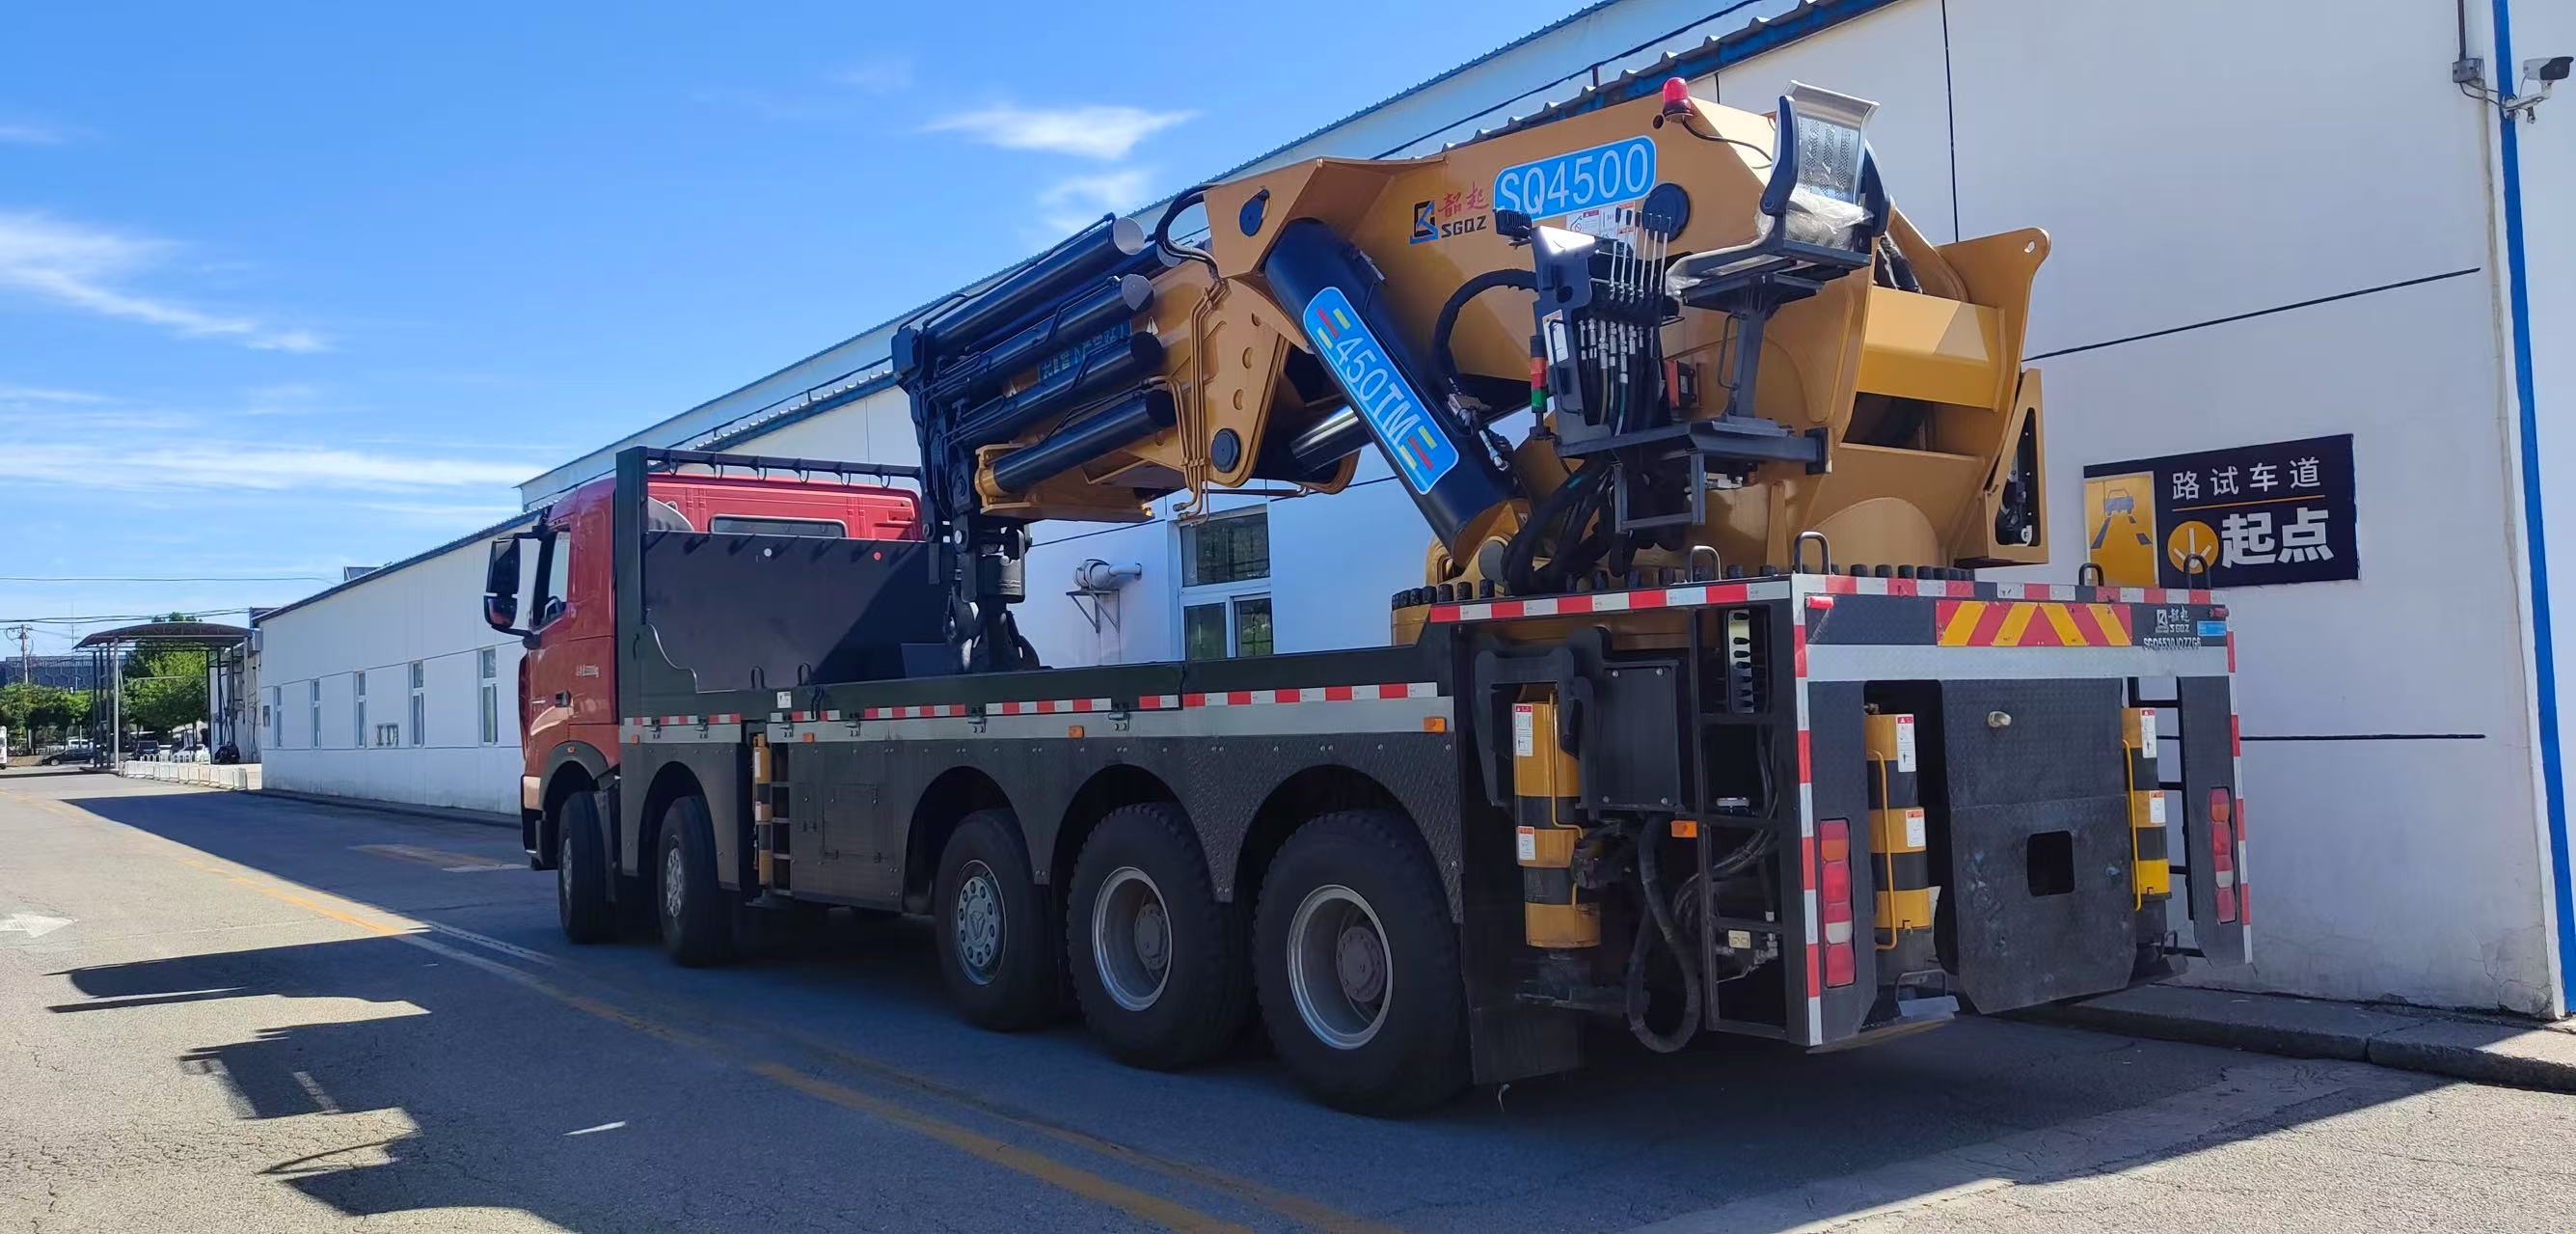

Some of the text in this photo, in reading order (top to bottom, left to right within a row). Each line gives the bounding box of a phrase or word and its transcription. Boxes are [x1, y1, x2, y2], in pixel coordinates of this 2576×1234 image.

[1500, 143, 1648, 214] SQ4500
[1441, 215, 1487, 238] SGQZ
[1334, 337, 1422, 448] 450TM
[2172, 456, 2321, 500] 路试车道
[2221, 507, 2335, 568] 起点
